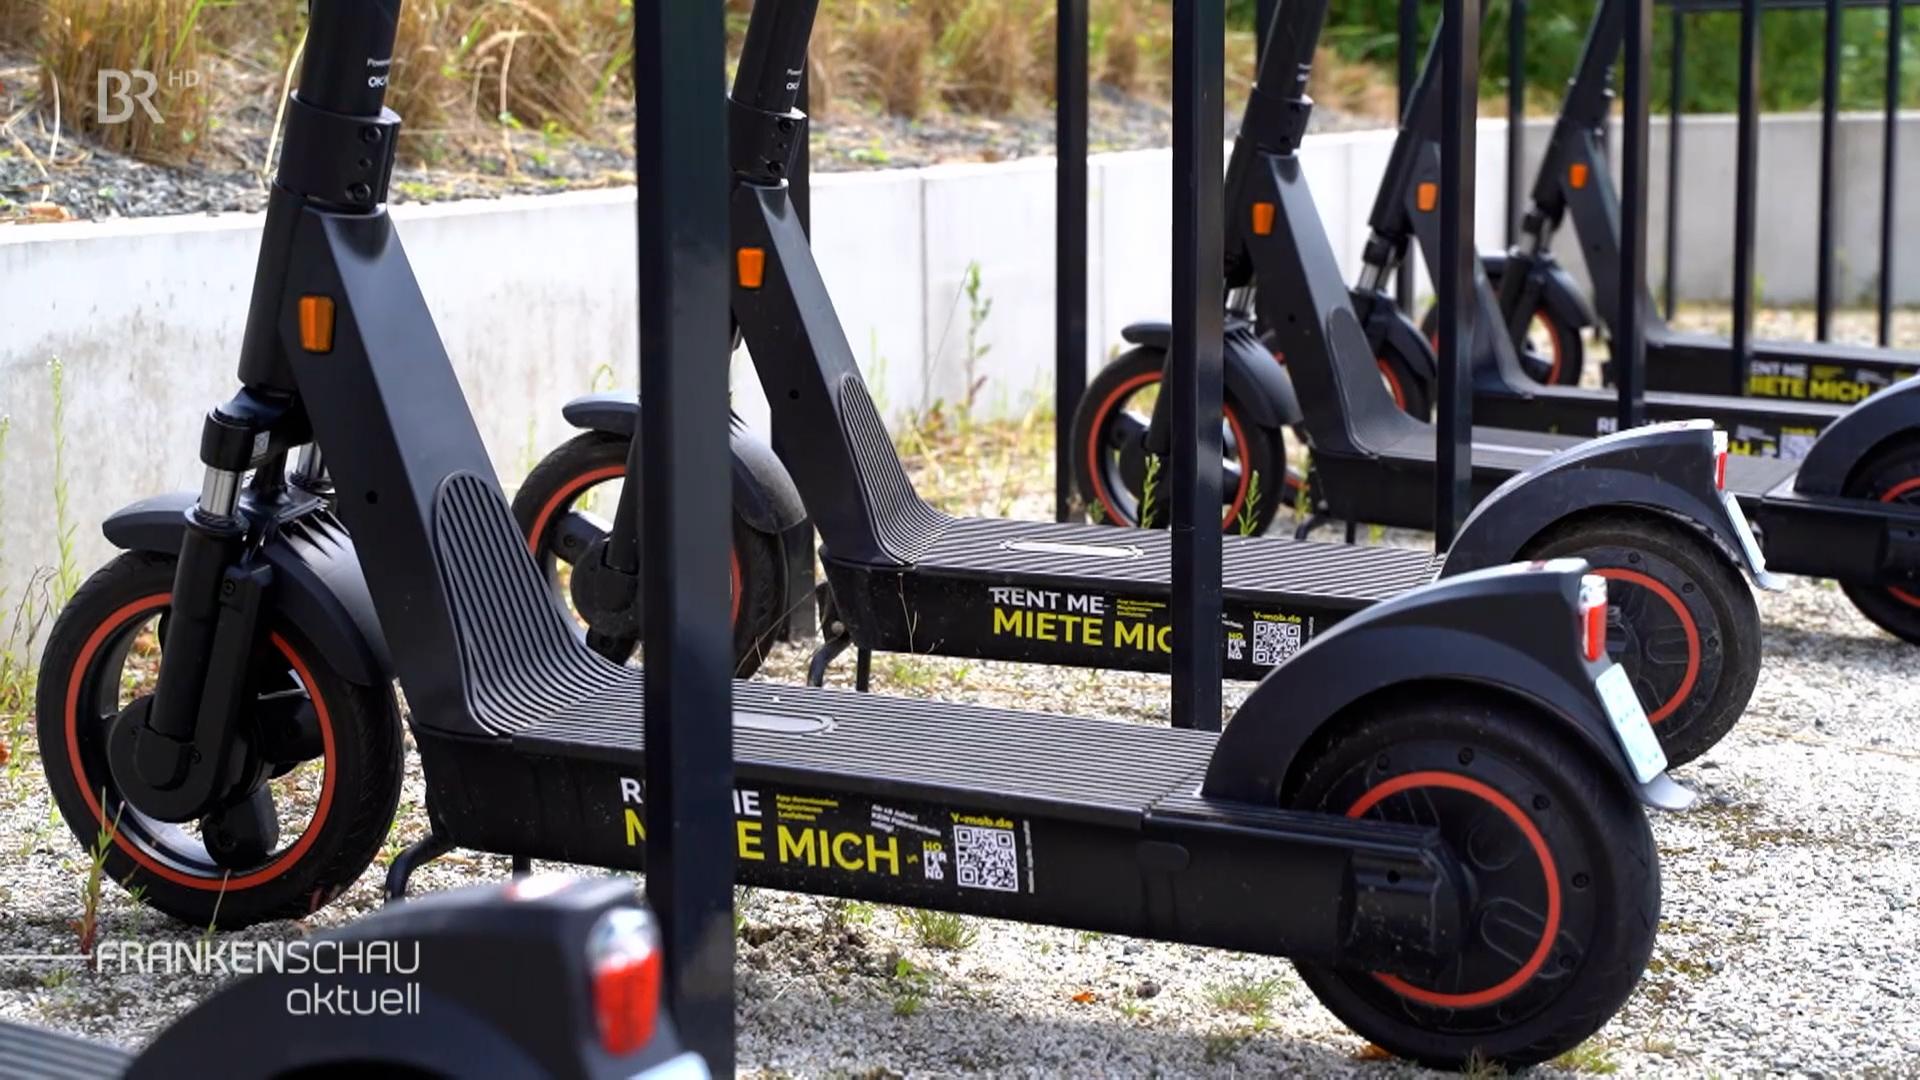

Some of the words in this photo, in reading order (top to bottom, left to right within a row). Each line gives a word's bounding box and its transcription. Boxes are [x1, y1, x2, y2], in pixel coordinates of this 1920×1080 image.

[992, 588, 1061, 610] RENT
[1067, 594, 1104, 614] ME
[994, 608, 1103, 645] MIETE
[1114, 620, 1172, 653] MIC
[950, 812, 1014, 829] Y-mob.de
[777, 824, 899, 875] MICH
